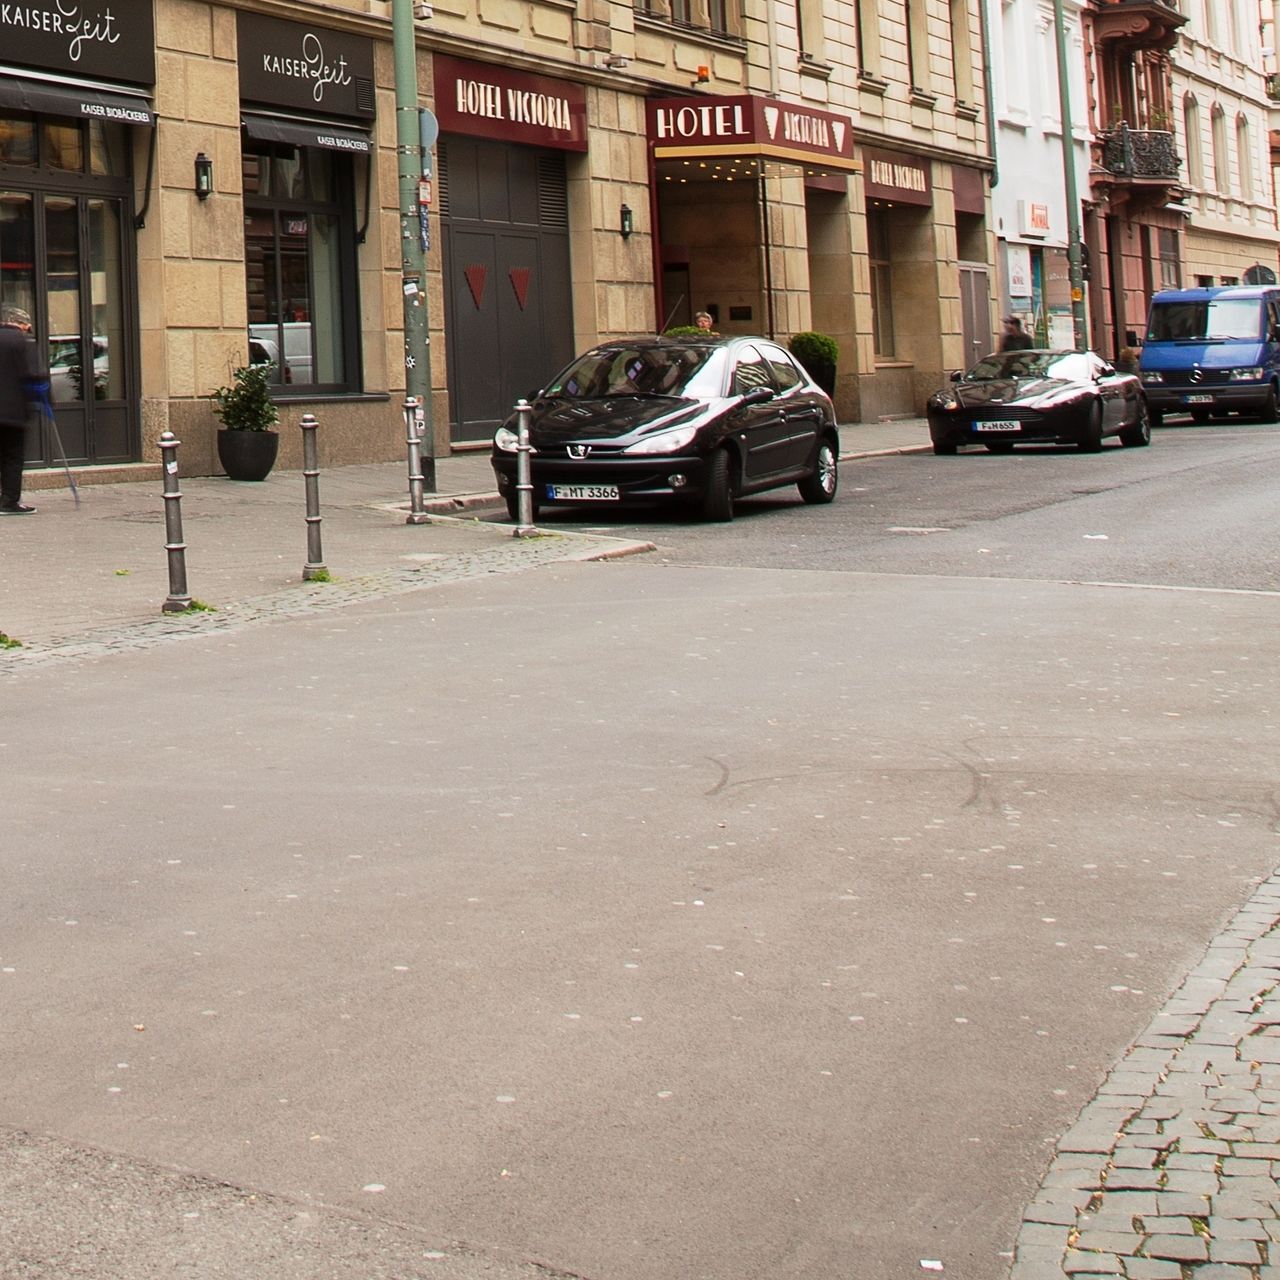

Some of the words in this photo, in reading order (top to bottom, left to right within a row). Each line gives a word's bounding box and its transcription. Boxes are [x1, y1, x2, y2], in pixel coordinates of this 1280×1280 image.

[81, 103, 106, 116] KAISER
[106, 106, 150, 122] BIOBÄCKEREI
[457, 79, 505, 120] HOTEL
[507, 89, 571, 131] VICTORIA
[657, 105, 750, 138] HOTEL
[554, 486, 561, 497] F
[569, 487, 584, 498] MT
[587, 487, 618, 499] 3366
